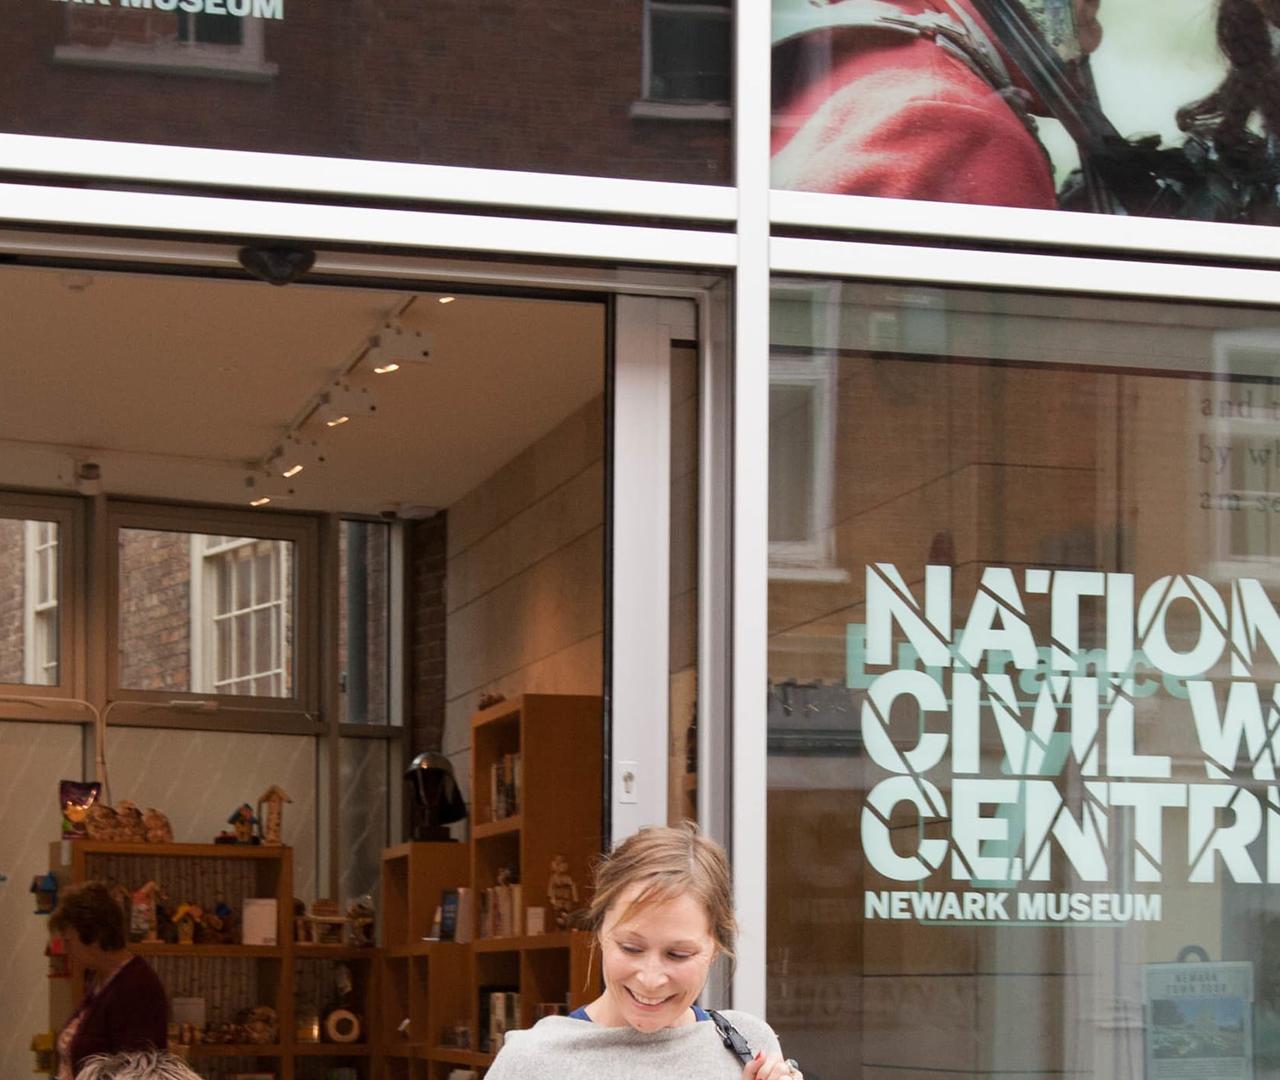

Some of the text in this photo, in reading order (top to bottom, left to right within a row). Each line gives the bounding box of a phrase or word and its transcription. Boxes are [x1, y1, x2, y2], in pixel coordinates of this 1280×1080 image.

[120, 0, 285, 20] EUM
[846, 622, 1210, 700] Enrance
[861, 669, 1171, 778] CIVIL
[864, 890, 1163, 921] NEWARK MUSEUM
